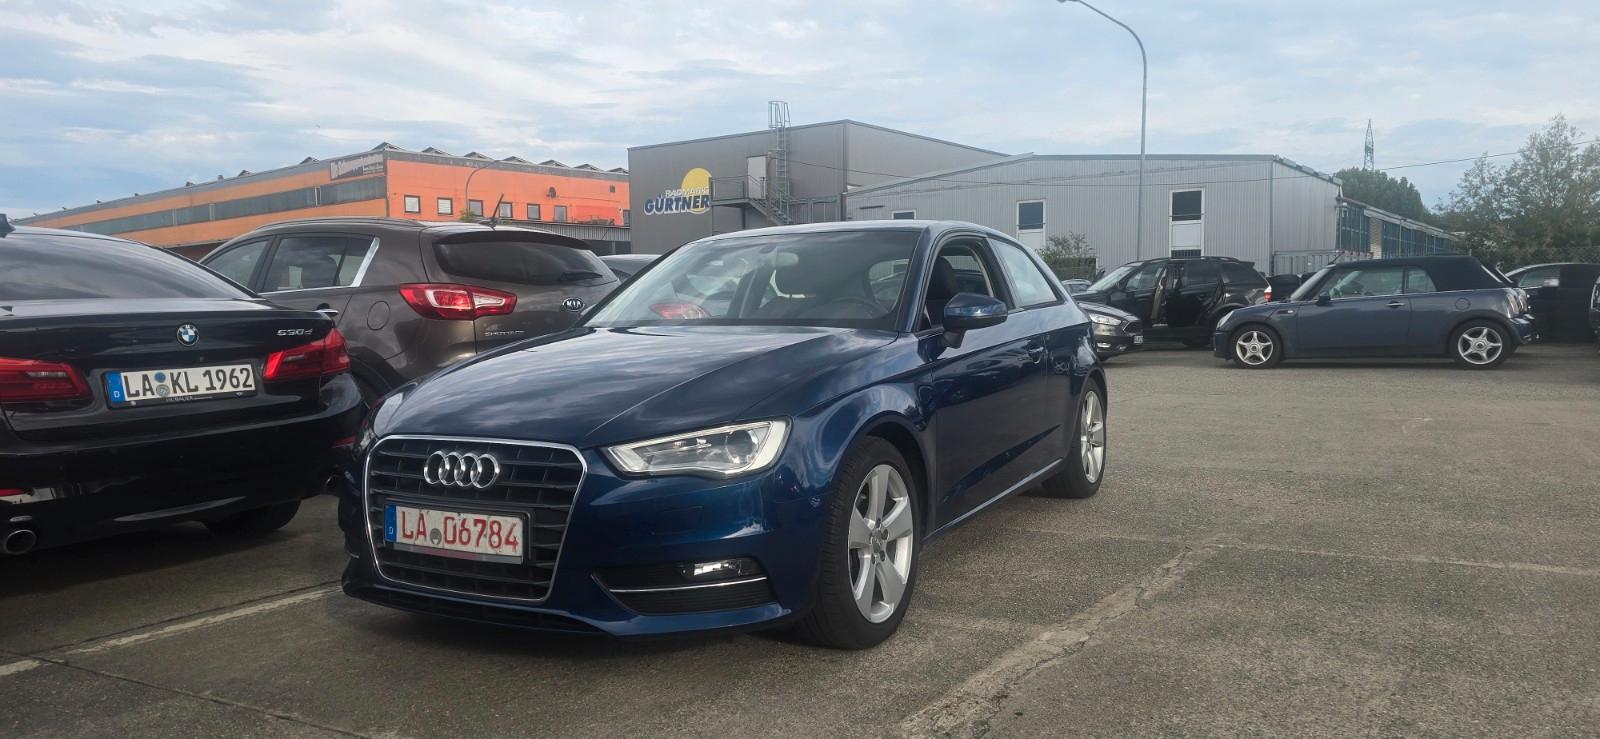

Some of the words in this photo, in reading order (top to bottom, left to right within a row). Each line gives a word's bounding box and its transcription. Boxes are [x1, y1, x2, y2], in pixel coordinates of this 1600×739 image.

[644, 194, 710, 215] GÜRTNER
[565, 300, 582, 310] KIA
[123, 374, 155, 398] LA
[169, 371, 199, 394] KL
[202, 367, 252, 391] 1962
[402, 511, 427, 541] LA
[443, 516, 519, 553] 06784
